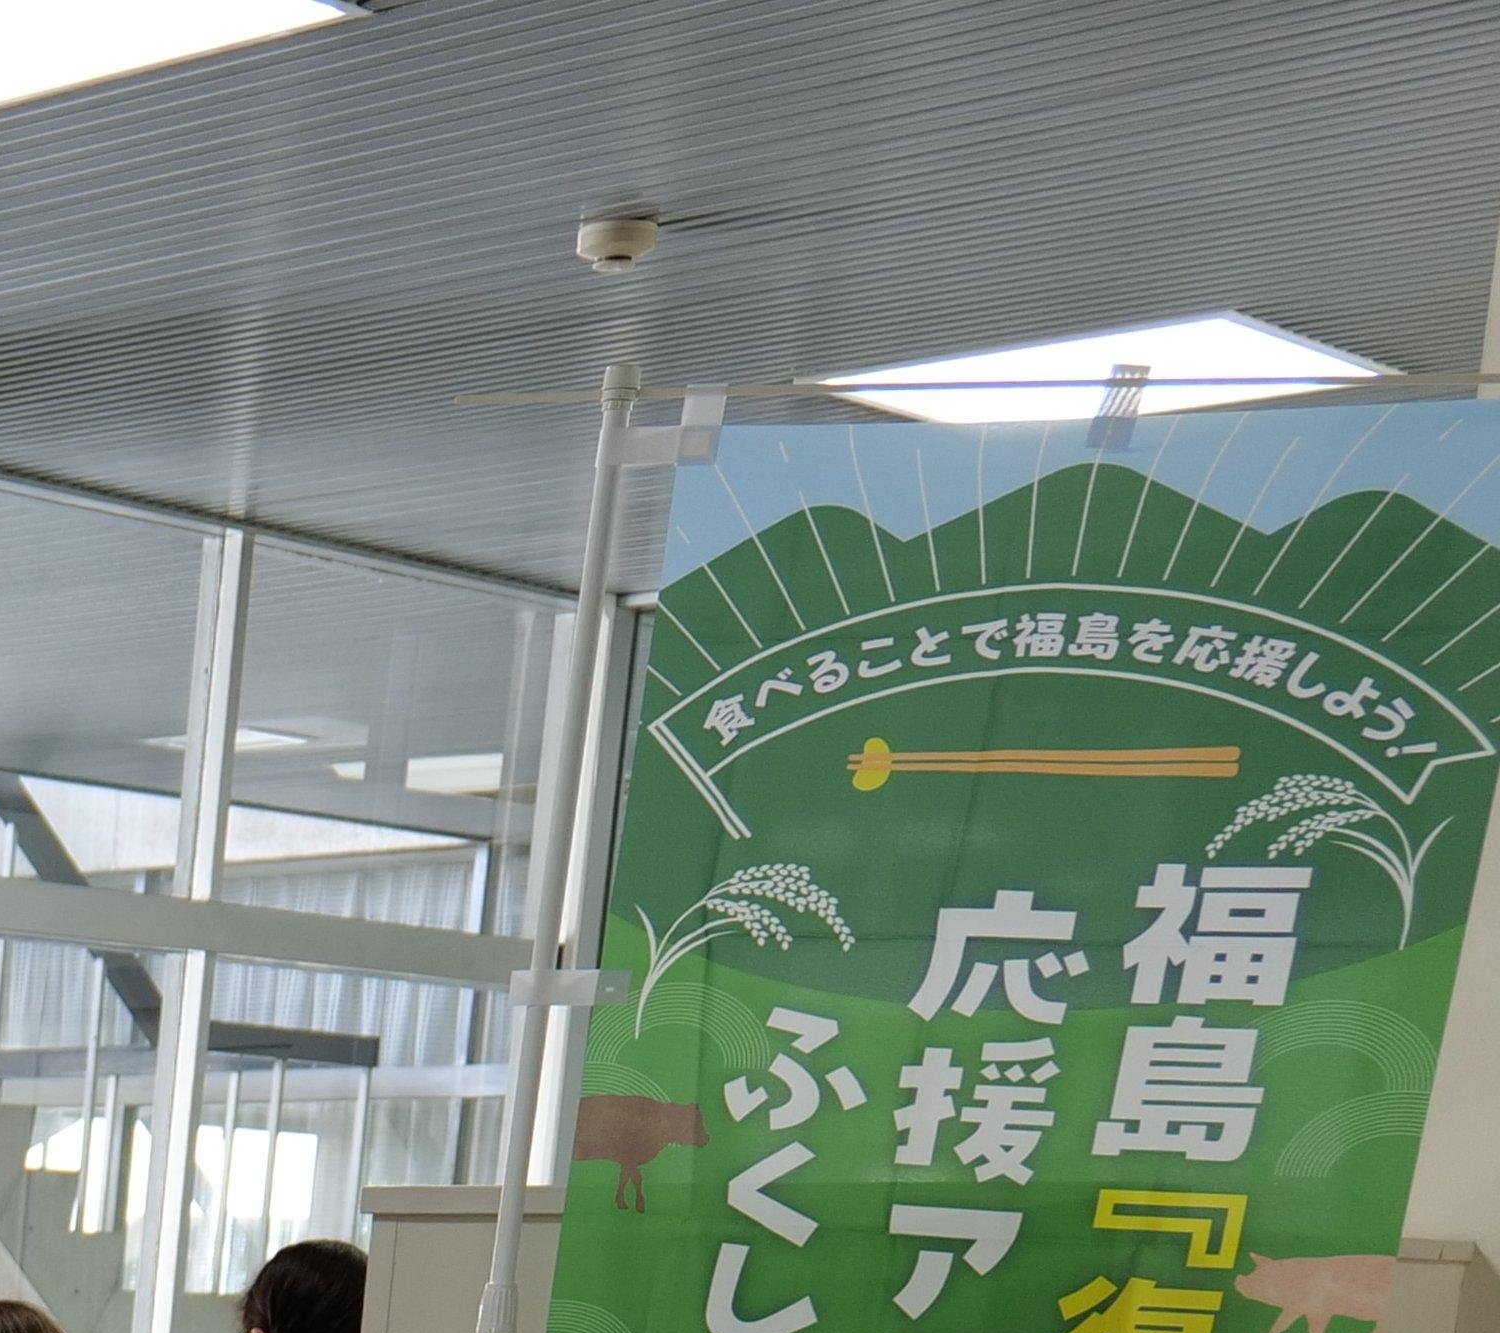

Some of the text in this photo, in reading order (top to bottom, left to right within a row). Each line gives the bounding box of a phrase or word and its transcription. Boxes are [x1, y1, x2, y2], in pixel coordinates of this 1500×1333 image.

[703, 612, 1438, 759] 食べることで福島を応援しよう!
